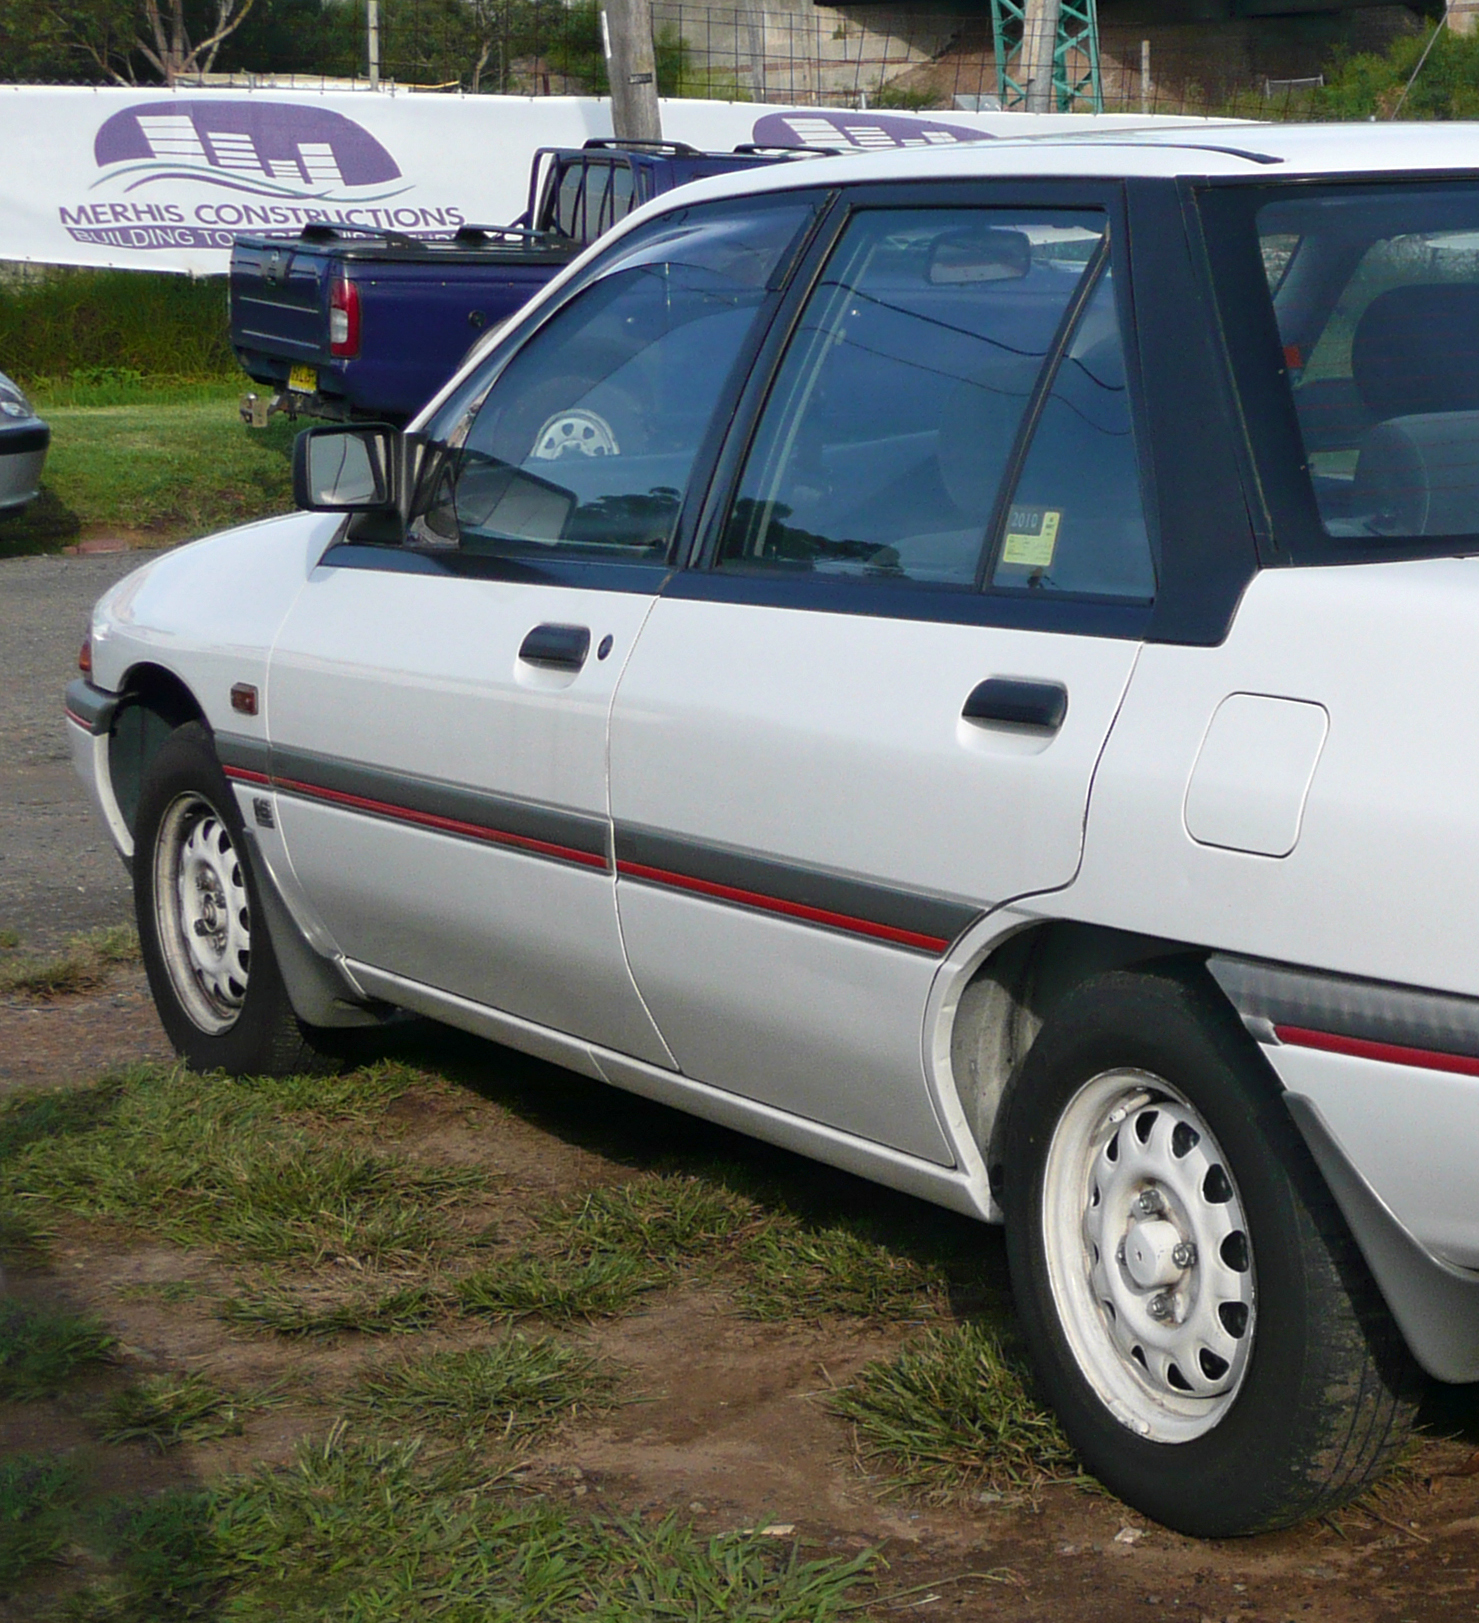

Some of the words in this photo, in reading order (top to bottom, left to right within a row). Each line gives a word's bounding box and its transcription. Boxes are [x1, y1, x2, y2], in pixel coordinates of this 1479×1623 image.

[59, 202, 185, 225] MERHIS
[194, 203, 466, 228] CONSTRUCTIONS
[72, 228, 195, 248] BUILDING
[1011, 512, 1039, 528] 2010
